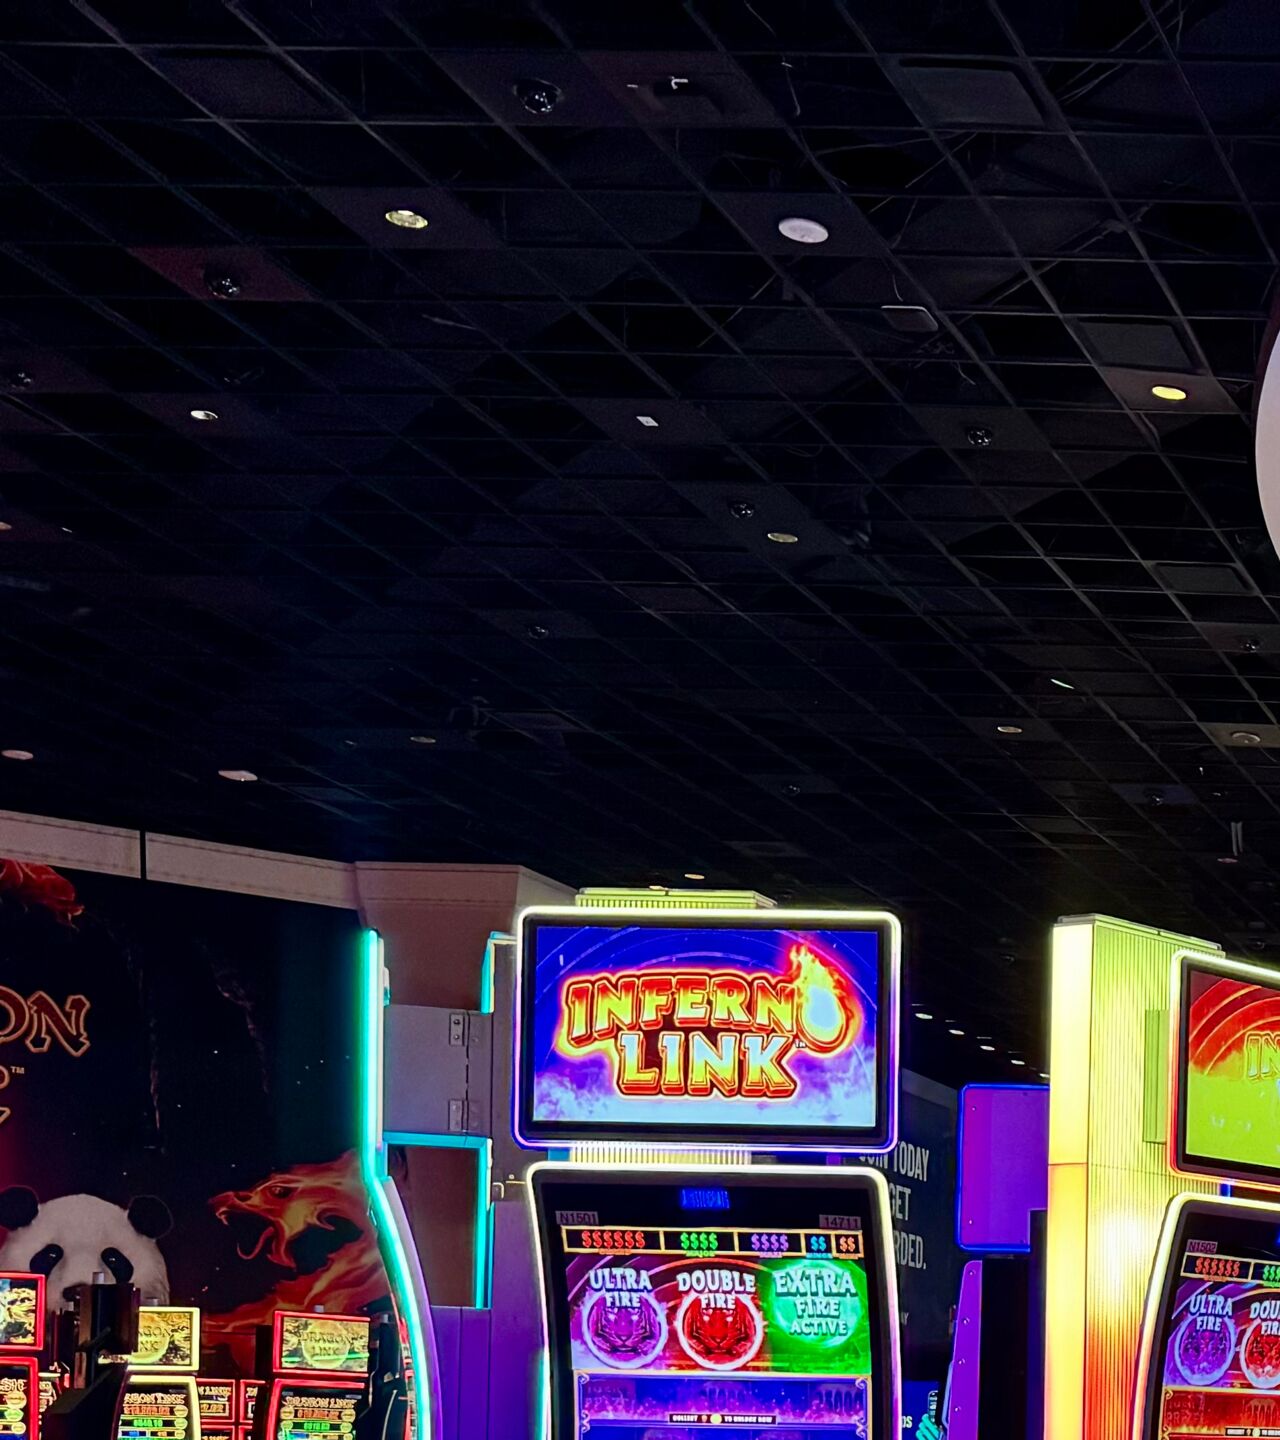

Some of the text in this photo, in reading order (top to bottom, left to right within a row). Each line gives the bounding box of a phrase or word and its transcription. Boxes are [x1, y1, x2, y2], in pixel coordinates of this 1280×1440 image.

[616, 1029, 797, 1097] LINK
[559, 1212, 598, 1225] N1501
[824, 1217, 861, 1229] 14711
[1188, 1241, 1216, 1253] N1502
[588, 1267, 652, 1291] ULTRA
[677, 1272, 756, 1294] DOUBLE
[773, 1269, 858, 1297] EXTRA
[606, 1292, 641, 1308] FIRE
[700, 1294, 736, 1310] FIRE
[1190, 1293, 1233, 1316] ULTRA
[795, 1299, 840, 1319] FIRE
[789, 1320, 849, 1336] ACTIVE
[1196, 1317, 1222, 1332] FIRE
